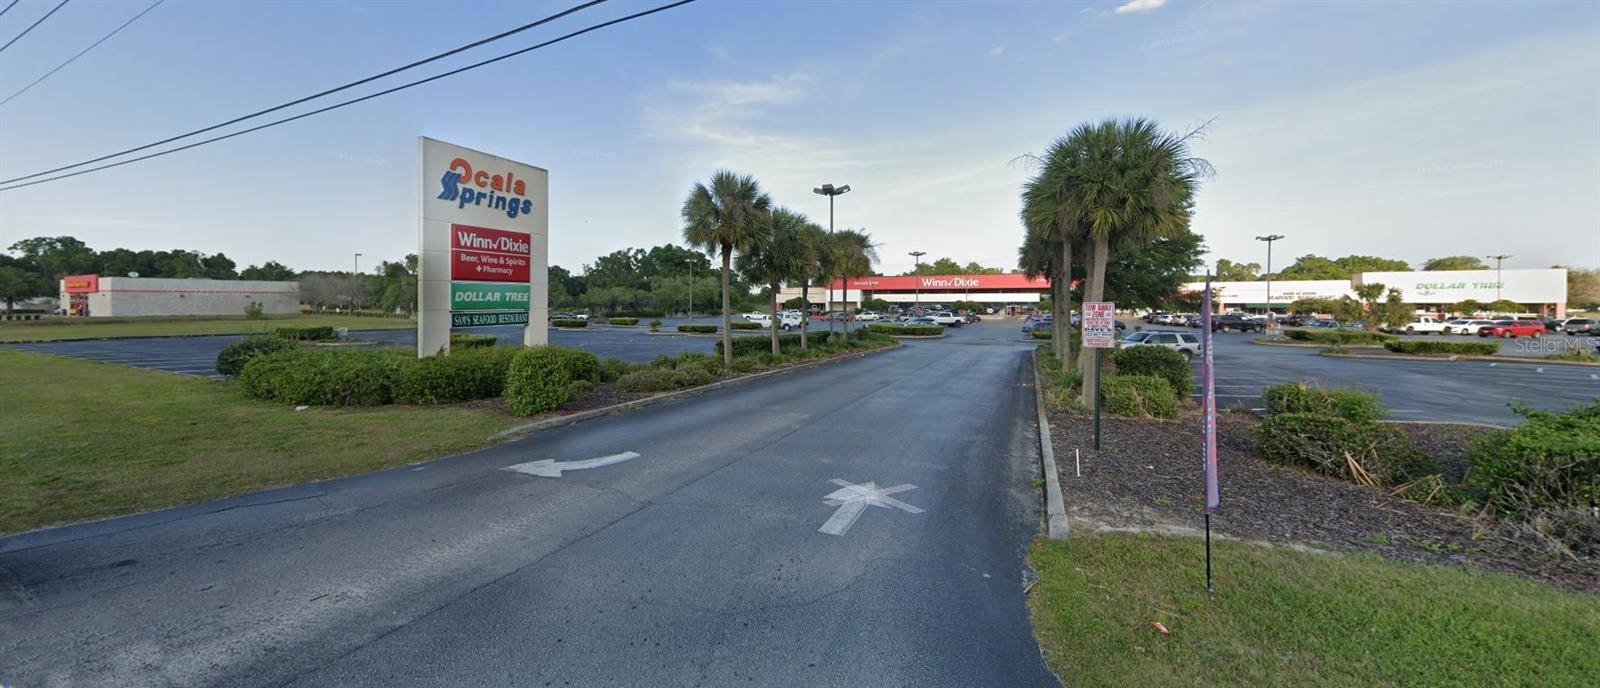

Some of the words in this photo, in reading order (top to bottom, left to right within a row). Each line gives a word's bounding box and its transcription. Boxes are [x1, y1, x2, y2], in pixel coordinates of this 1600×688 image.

[449, 157, 526, 196] Ocala
[437, 170, 533, 219] Springs
[461, 254, 479, 265] Beer,
[480, 256, 499, 265] Wine
[499, 257, 505, 265] &
[505, 257, 526, 267] Spirits
[483, 266, 513, 275] Pharmacy
[1415, 282, 1466, 290] DOLLAR
[455, 291, 501, 302] DOLLAR
[505, 292, 529, 302] TREE
[473, 314, 497, 324] SEAFOOD
[498, 313, 528, 323] RESTAURANT
